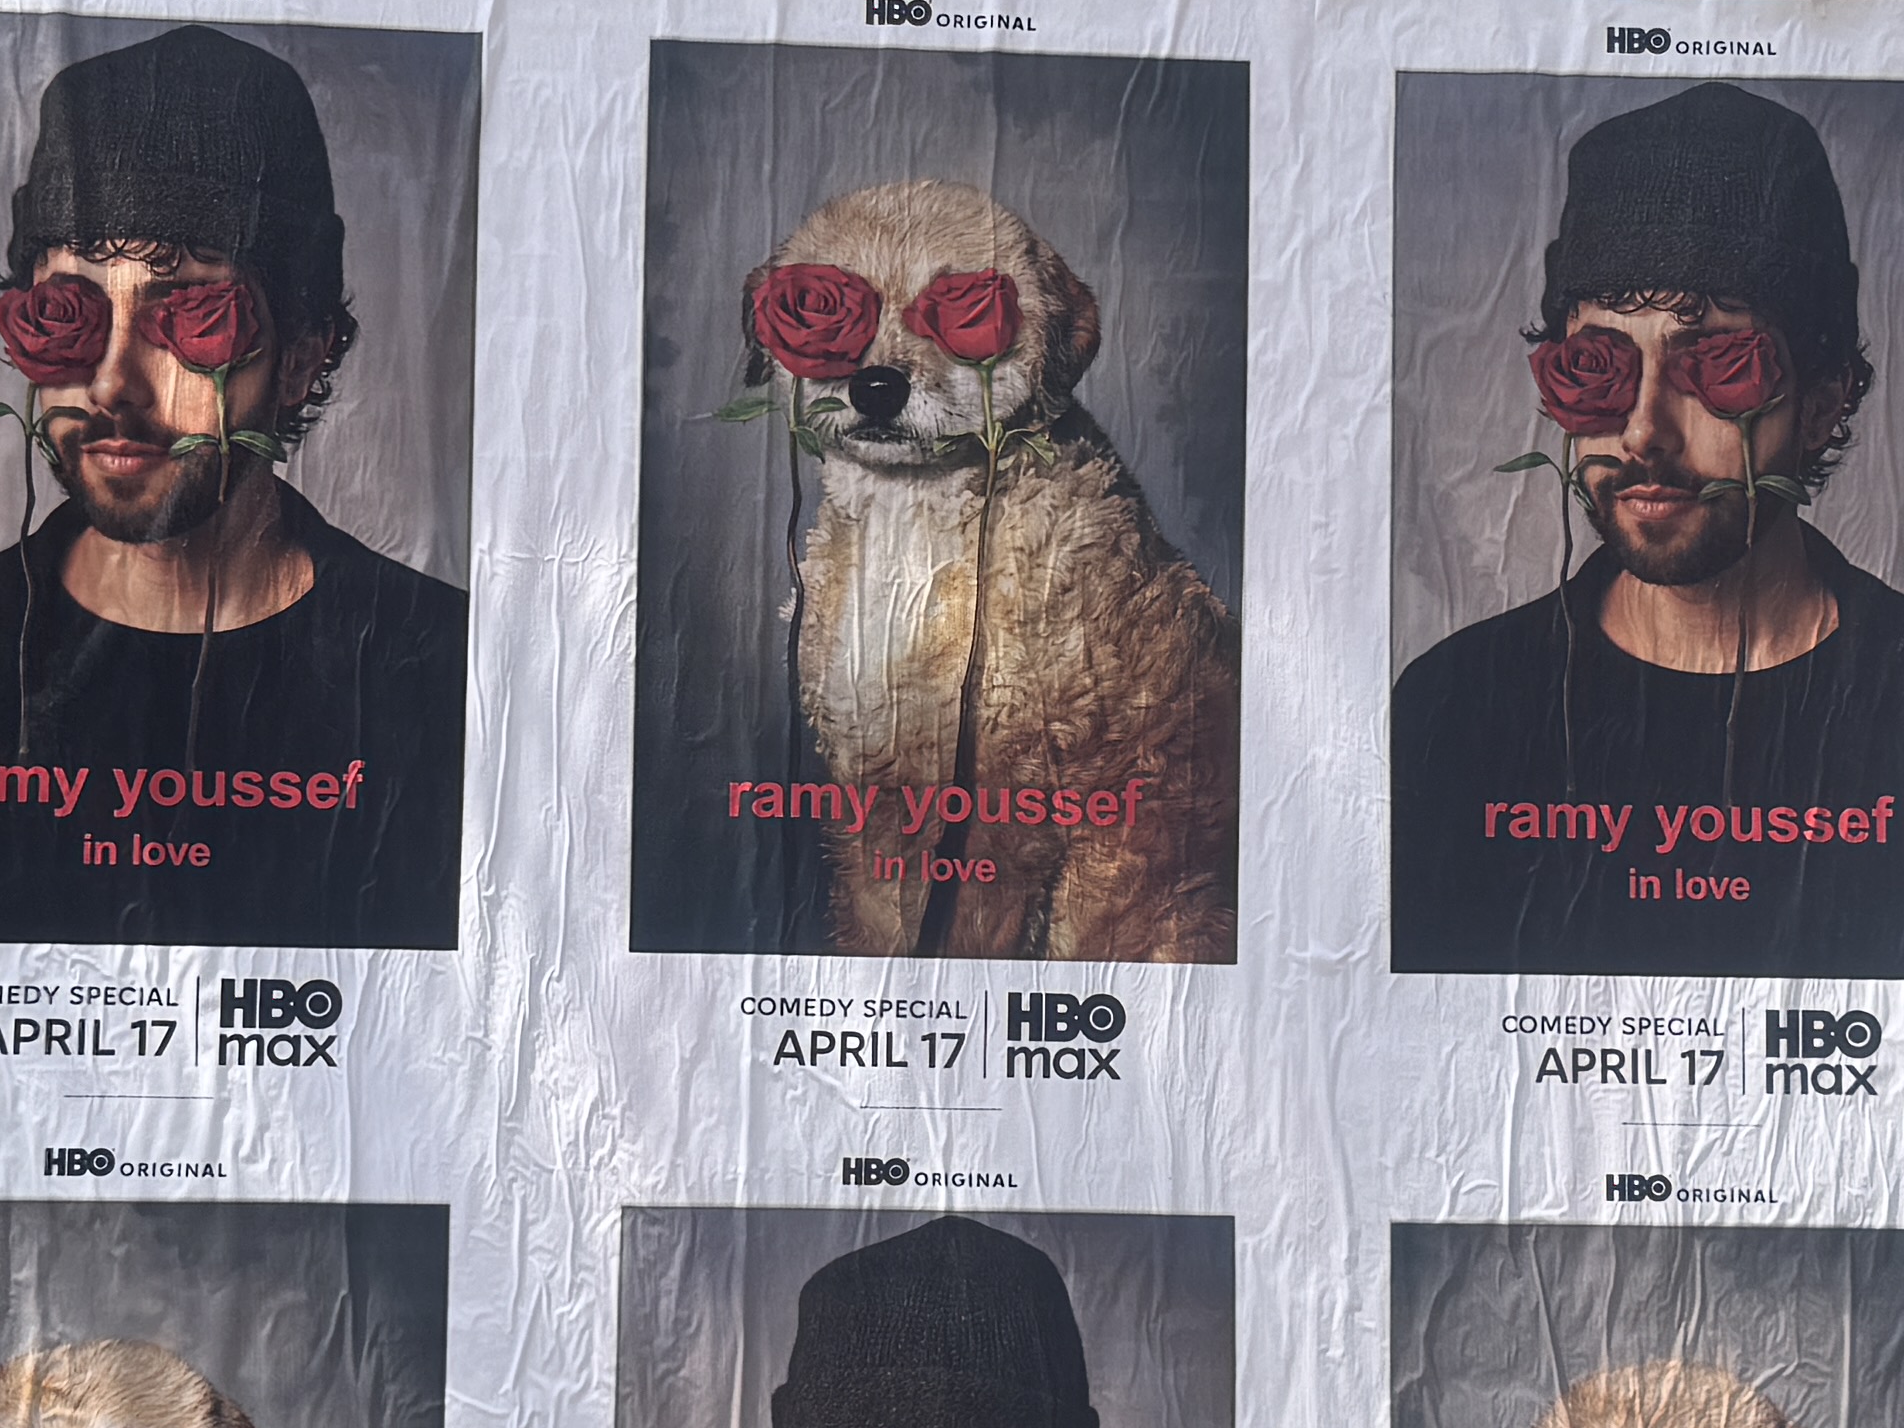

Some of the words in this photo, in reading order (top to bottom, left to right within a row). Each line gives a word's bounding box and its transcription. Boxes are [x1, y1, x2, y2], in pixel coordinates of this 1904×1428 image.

[936, 14, 1036, 31] ORIGINAL
[1606, 27, 1671, 54] HBO
[1676, 40, 1777, 55] ORIGINAL
[113, 760, 365, 817] youssef
[728, 781, 878, 834] ramy
[902, 781, 1142, 834] youssef
[1485, 801, 1632, 852] ramy
[1655, 796, 1895, 853] youssef
[82, 834, 117, 865] in
[132, 835, 211, 867] love
[872, 850, 905, 881] in
[920, 851, 996, 882] love
[1628, 868, 1661, 899] in
[1675, 869, 1750, 901] love
[70, 986, 178, 1007] SPECIAL
[219, 978, 342, 1029] HBO
[740, 996, 853, 1017] COMEDY
[863, 999, 967, 1019] SPECIAL
[1007, 992, 1126, 1042] HBO
[1502, 1015, 1611, 1035] COMEDY
[1622, 1016, 1724, 1036] SPECIAL
[130, 1020, 177, 1057] 17
[218, 1033, 336, 1068] max
[773, 1029, 907, 1068] APRIL
[920, 1032, 966, 1069] 17
[1766, 1010, 1882, 1058] HBO
[1006, 1046, 1121, 1080] max
[1535, 1048, 1667, 1085] APRIL
[1680, 1050, 1725, 1086] 17
[1766, 1063, 1878, 1096] max
[44, 1147, 115, 1177] HBO
[120, 1162, 227, 1178] ORIGINAL
[842, 1157, 910, 1186] HBO
[914, 1170, 1018, 1188] ORIGINAL
[1606, 1174, 1672, 1202] HBO
[1676, 1186, 1778, 1204] ORIGINAL
